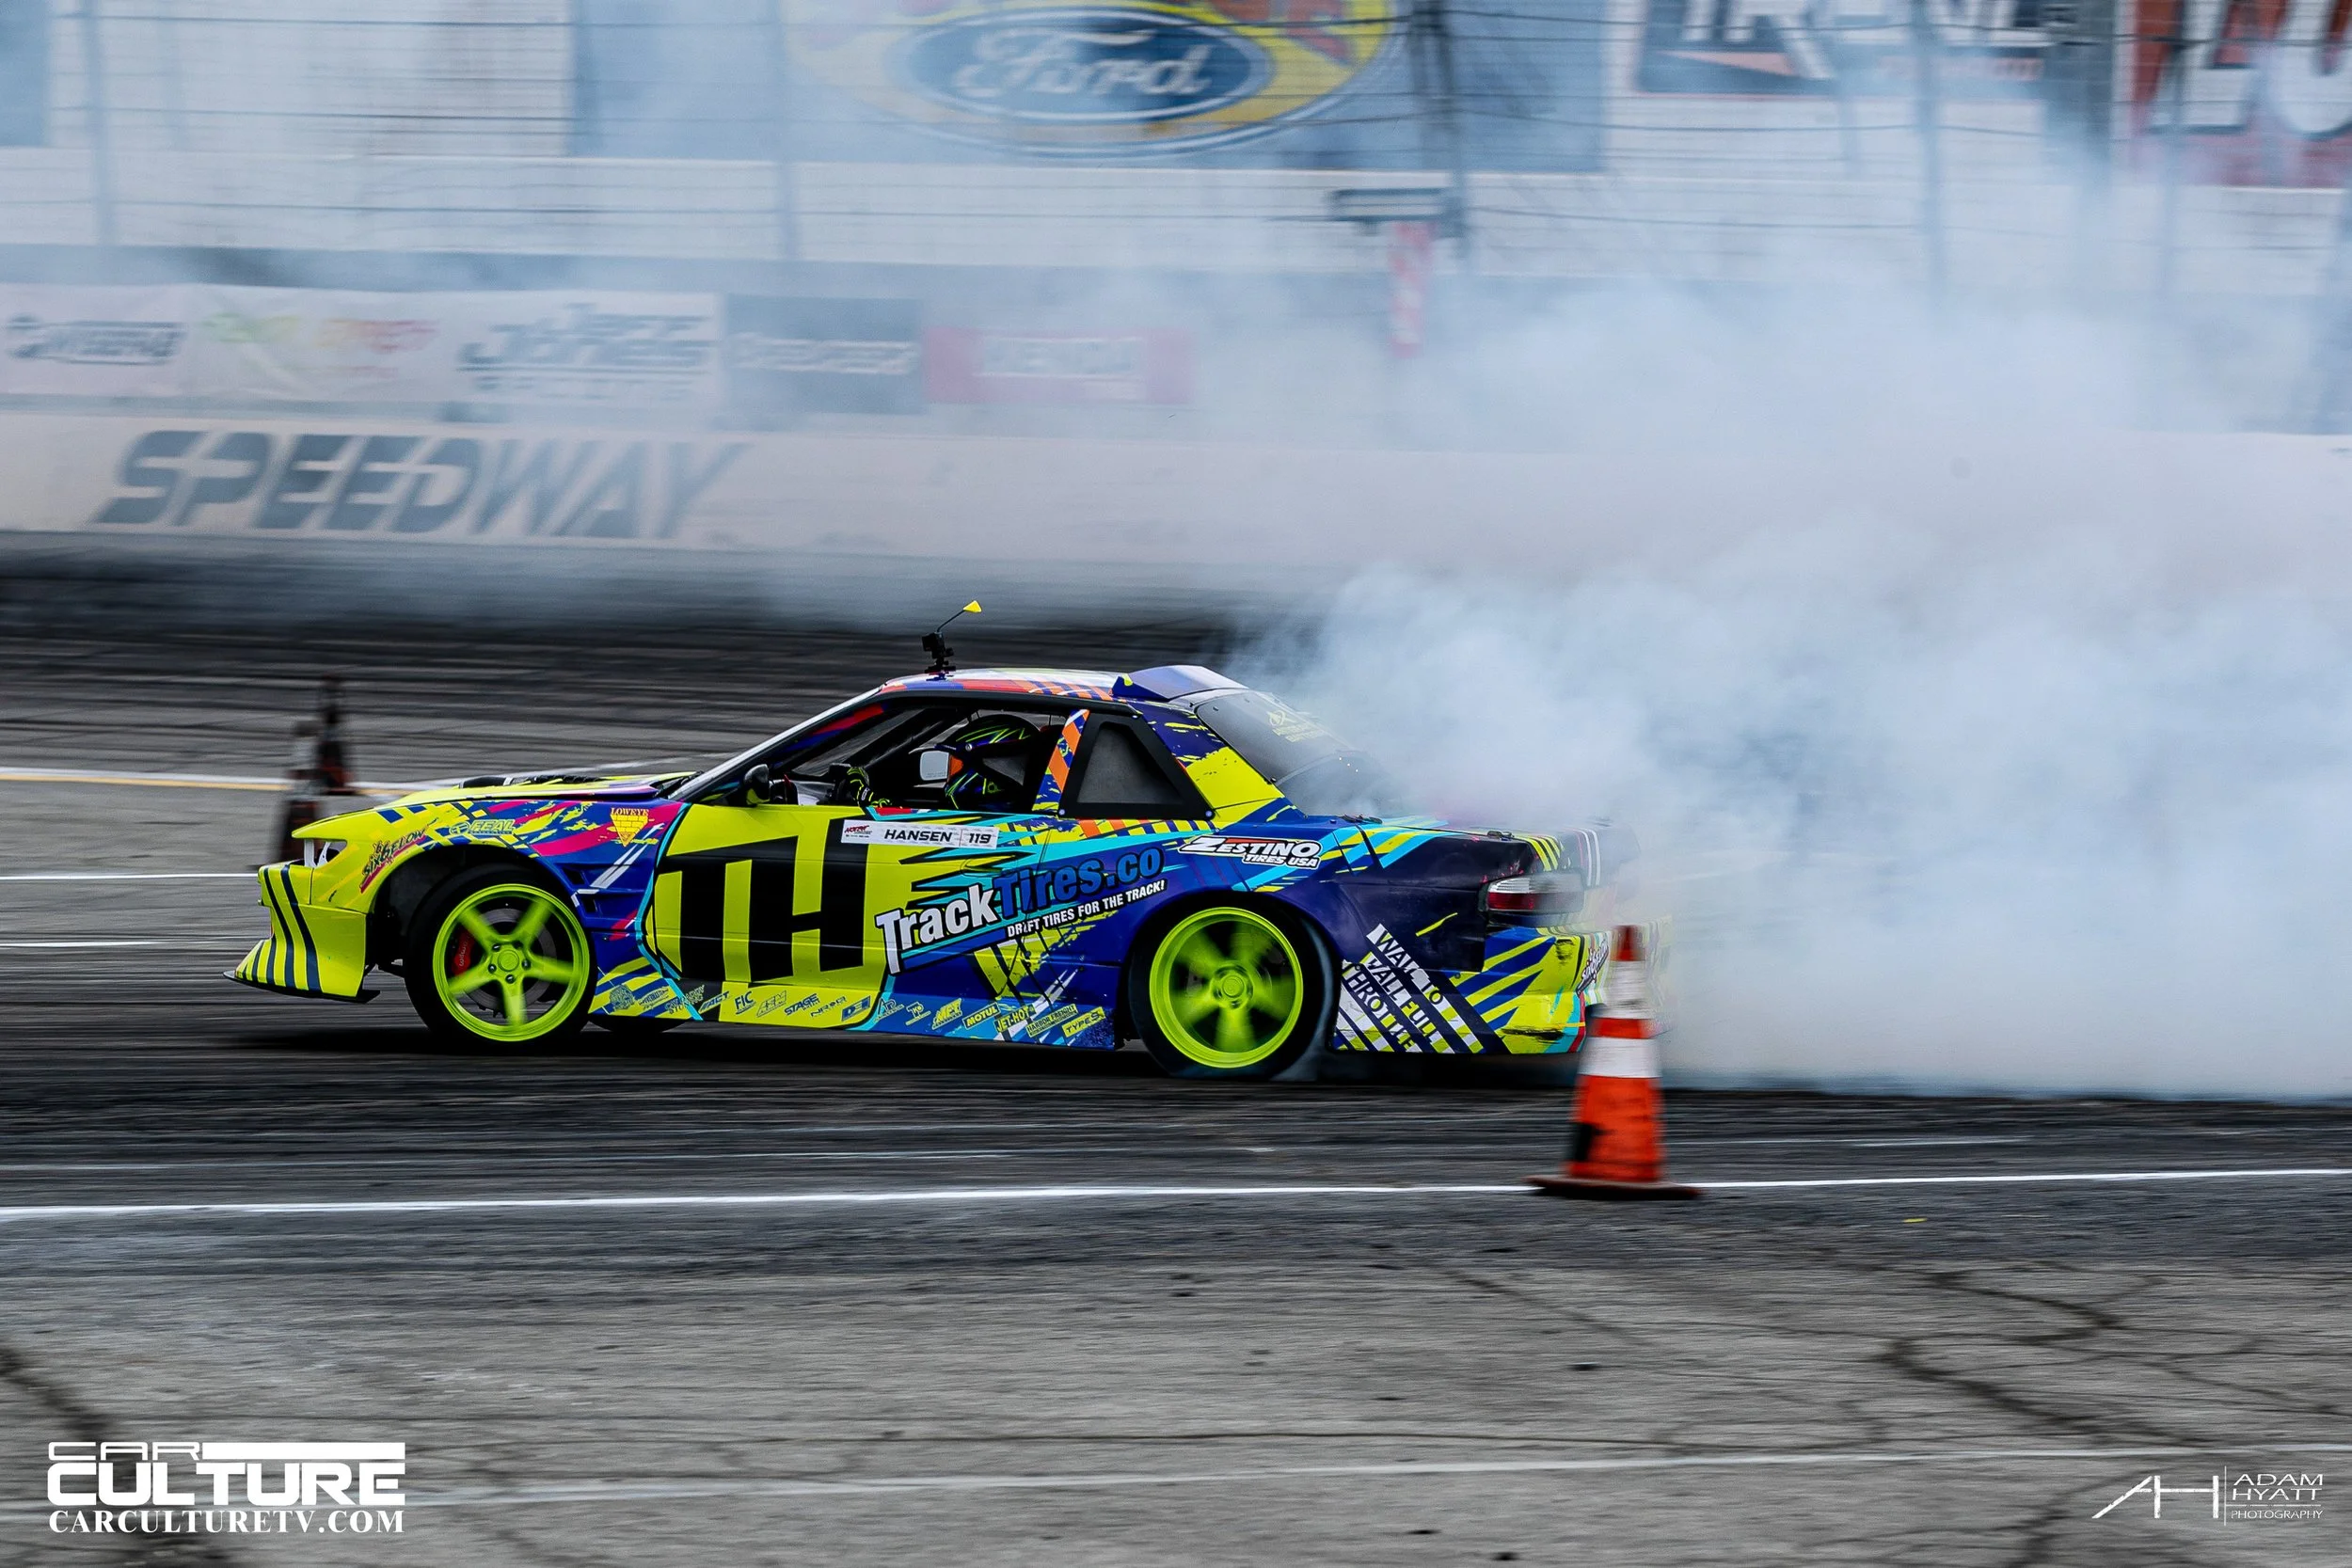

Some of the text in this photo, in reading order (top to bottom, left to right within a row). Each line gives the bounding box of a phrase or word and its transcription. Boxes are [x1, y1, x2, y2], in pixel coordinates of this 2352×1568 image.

[951, 27, 1213, 96] Ford
[86, 429, 755, 540] SPEEDWAY
[884, 829, 992, 845] HANSEN 119
[1180, 836, 1320, 858] ZESTINO
[1245, 854, 1319, 867] TIRES USA
[1008, 879, 1166, 938] DRIFT TIRES FOR THE TRACK!
[734, 990, 754, 1009] FIC
[784, 993, 818, 1016] STAGE
[1367, 957, 1438, 1045] WALL FULL
[966, 1006, 999, 1026] MOTUL
[1026, 1005, 1076, 1033] HARBOR FREIGHT
